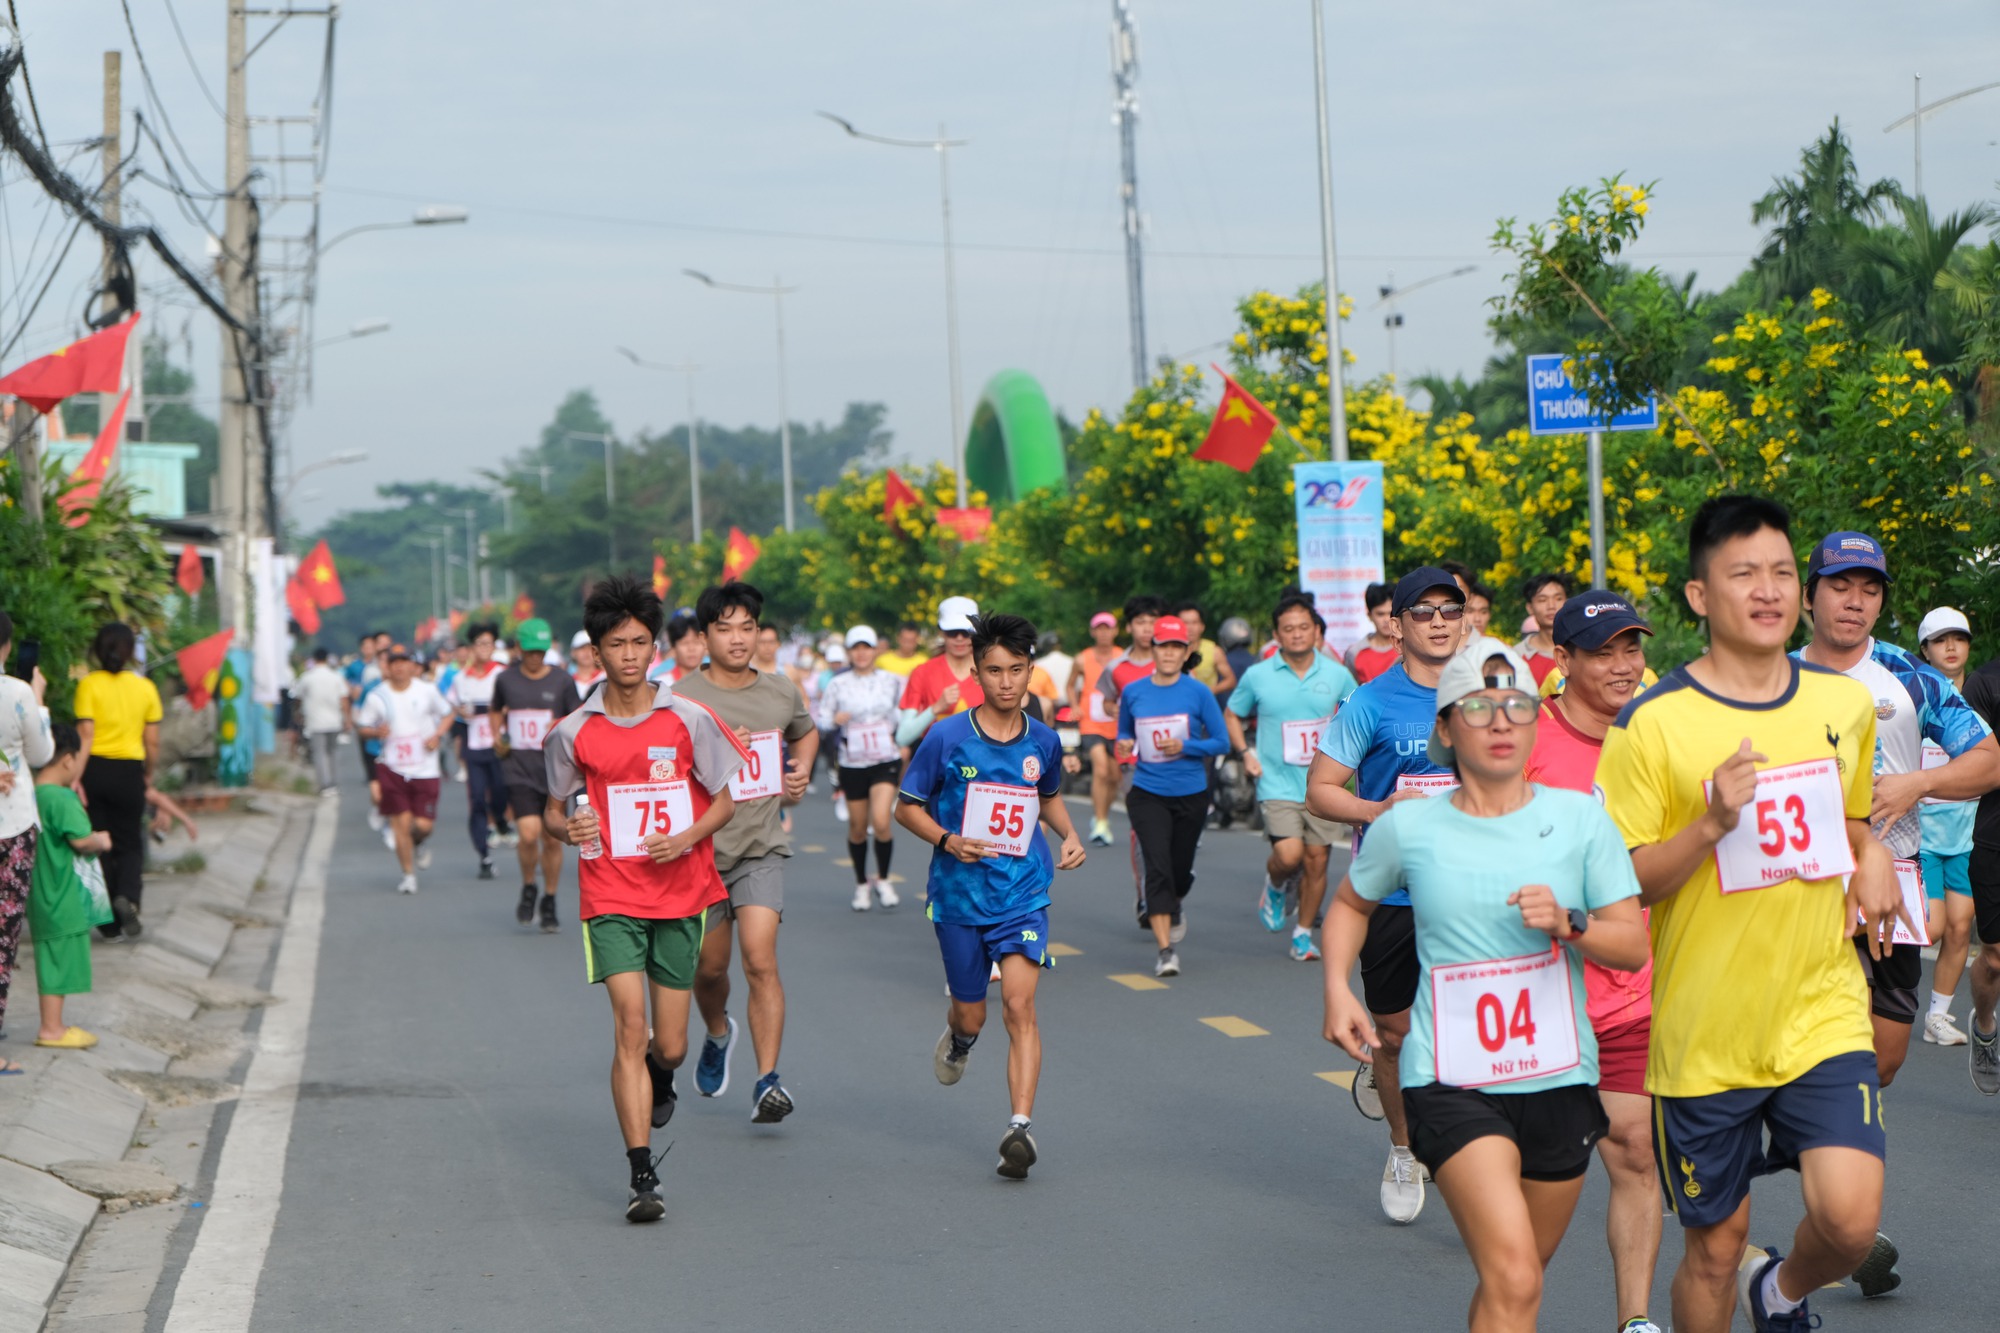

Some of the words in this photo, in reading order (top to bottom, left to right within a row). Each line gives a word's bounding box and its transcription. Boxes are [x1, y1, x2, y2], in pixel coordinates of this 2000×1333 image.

[1300, 731, 1319, 754] 13
[740, 788, 758, 796] Nam
[634, 800, 672, 837] 75
[988, 802, 1025, 839] 55
[1756, 794, 1811, 857] 53
[1761, 866, 1798, 881] Nam
[1802, 858, 1820, 875] trẻ
[1476, 987, 1536, 1053] 04
[1491, 1059, 1514, 1076] Nữ
[1518, 1054, 1539, 1071] trẻ
